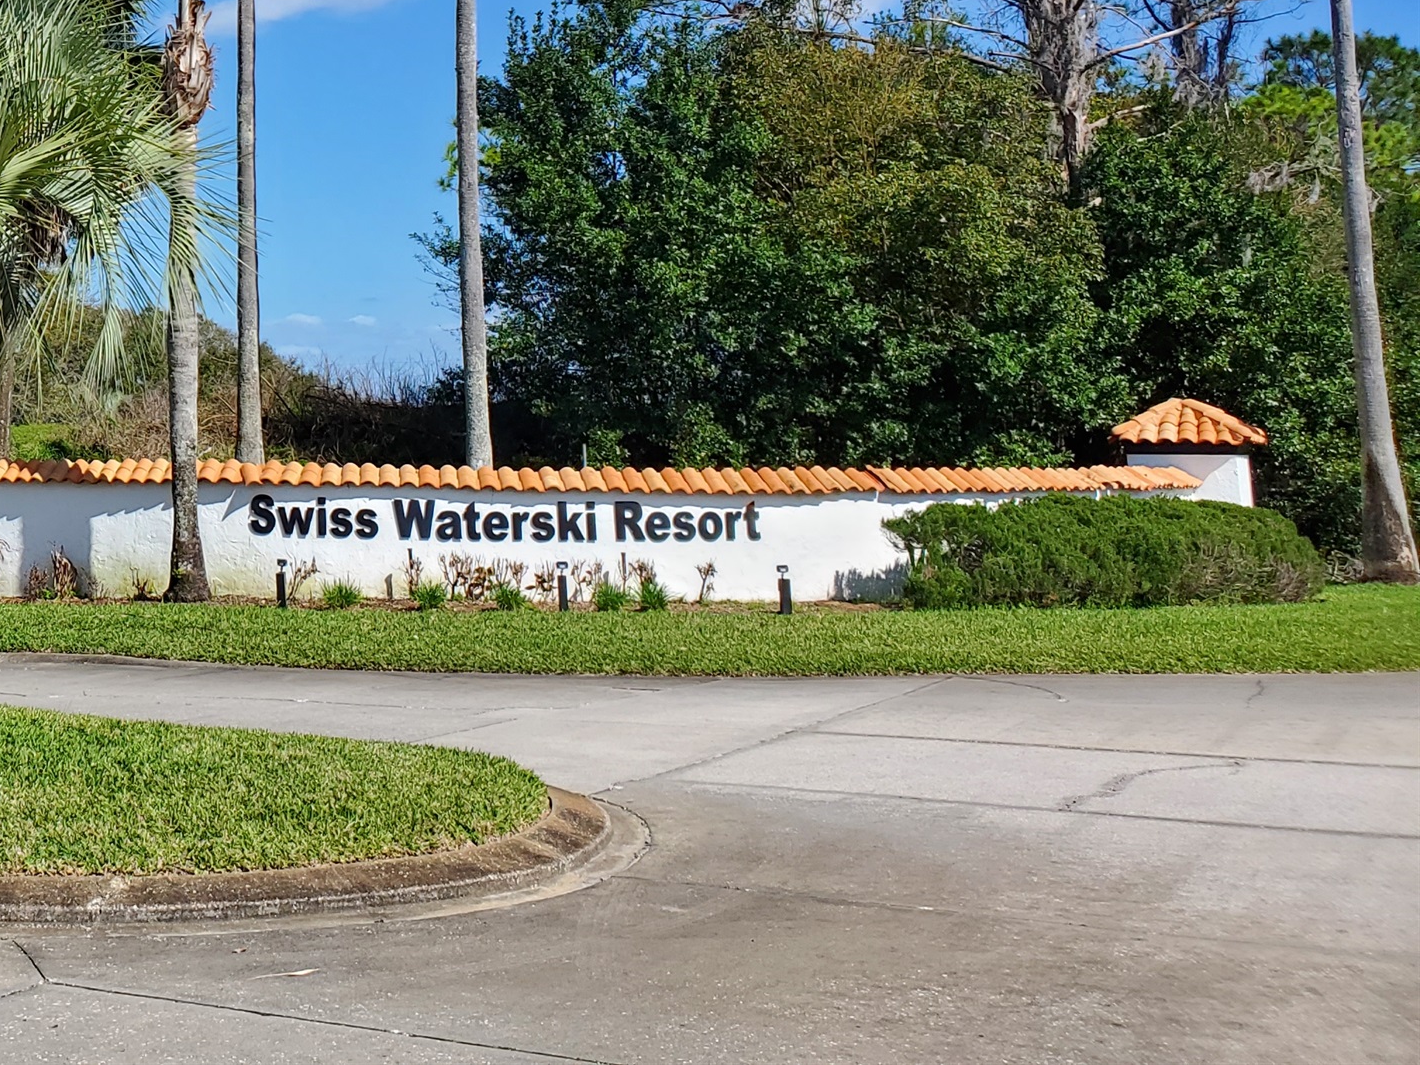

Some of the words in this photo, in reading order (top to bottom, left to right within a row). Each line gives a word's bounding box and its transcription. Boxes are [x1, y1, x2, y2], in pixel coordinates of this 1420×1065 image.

[248, 494, 378, 538] Swiss
[393, 499, 597, 541] Waterski
[614, 501, 761, 541] Resort
